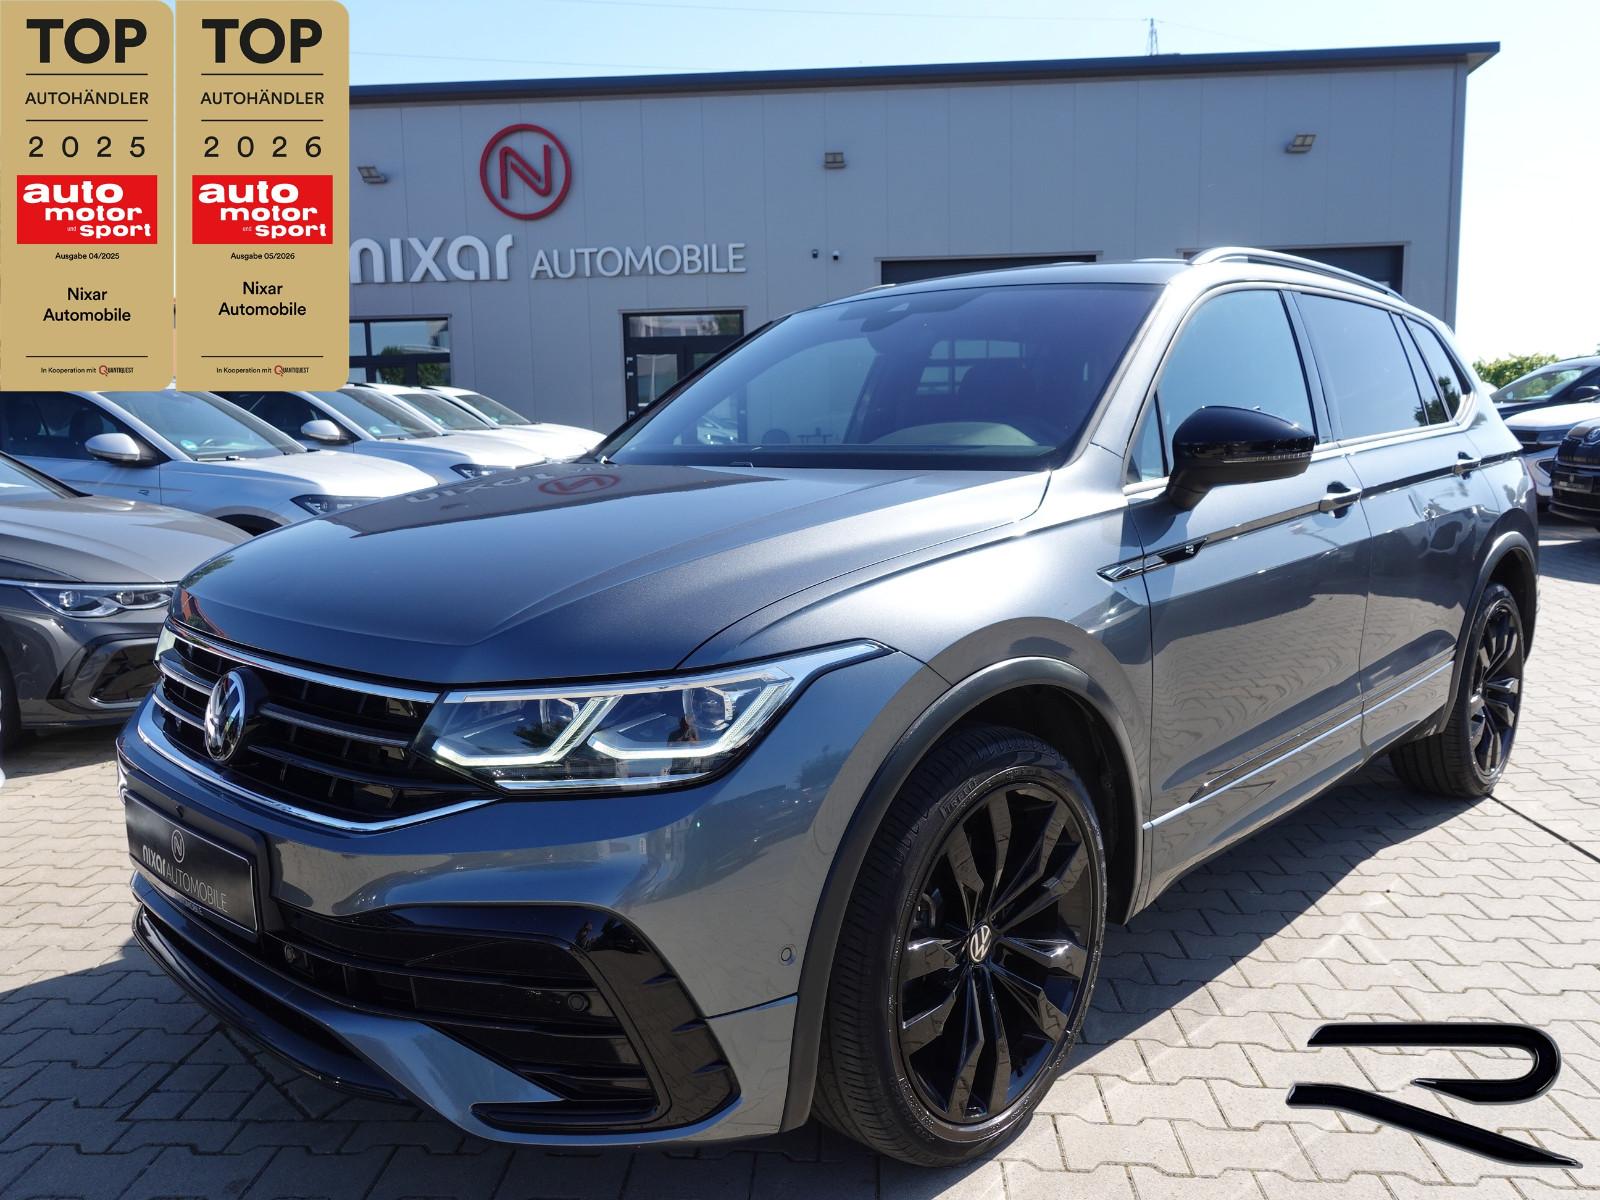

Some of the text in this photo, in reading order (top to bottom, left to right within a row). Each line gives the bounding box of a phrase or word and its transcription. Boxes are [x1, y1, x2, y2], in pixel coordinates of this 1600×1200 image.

[349, 233, 747, 284] nixar AUTOMOBILE
[142, 845, 166, 877] nixar
[166, 863, 228, 913] AUTOMOBILE
